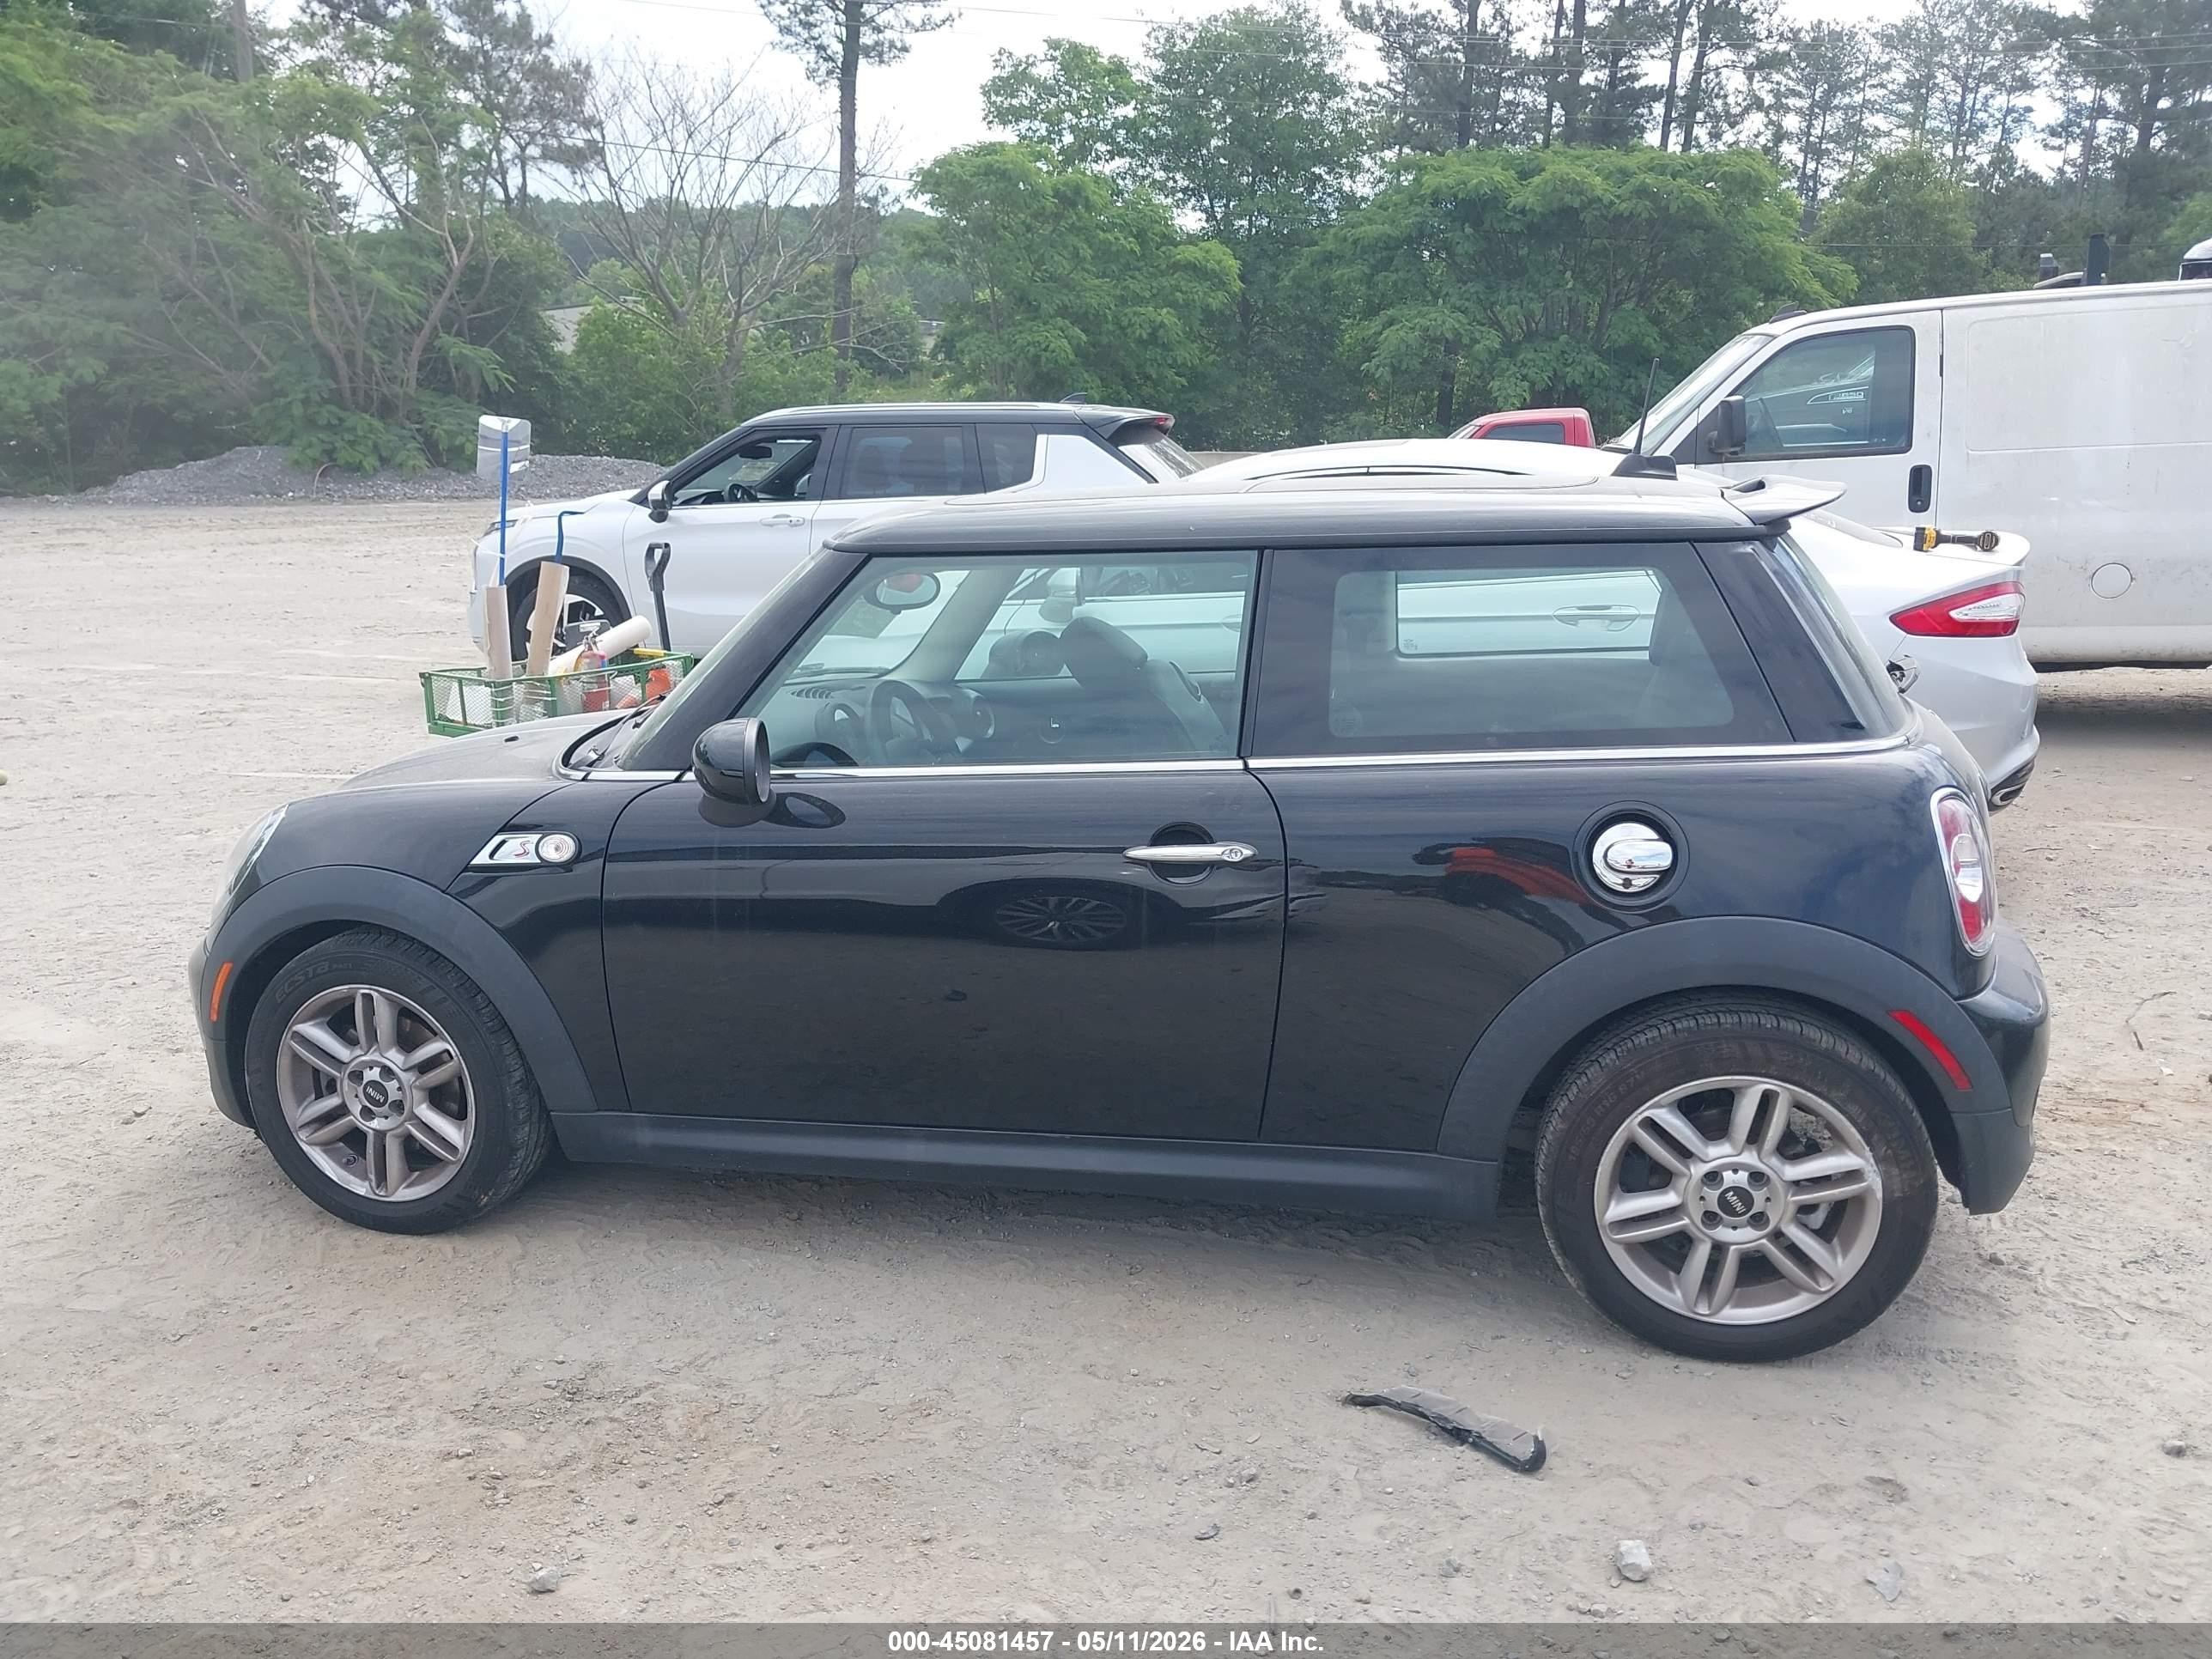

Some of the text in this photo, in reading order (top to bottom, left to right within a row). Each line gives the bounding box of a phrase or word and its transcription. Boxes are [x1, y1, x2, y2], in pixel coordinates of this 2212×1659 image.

[514, 840, 532, 858] S
[366, 1085, 385, 1103] MINI
[1724, 1191, 1747, 1214] MINI
